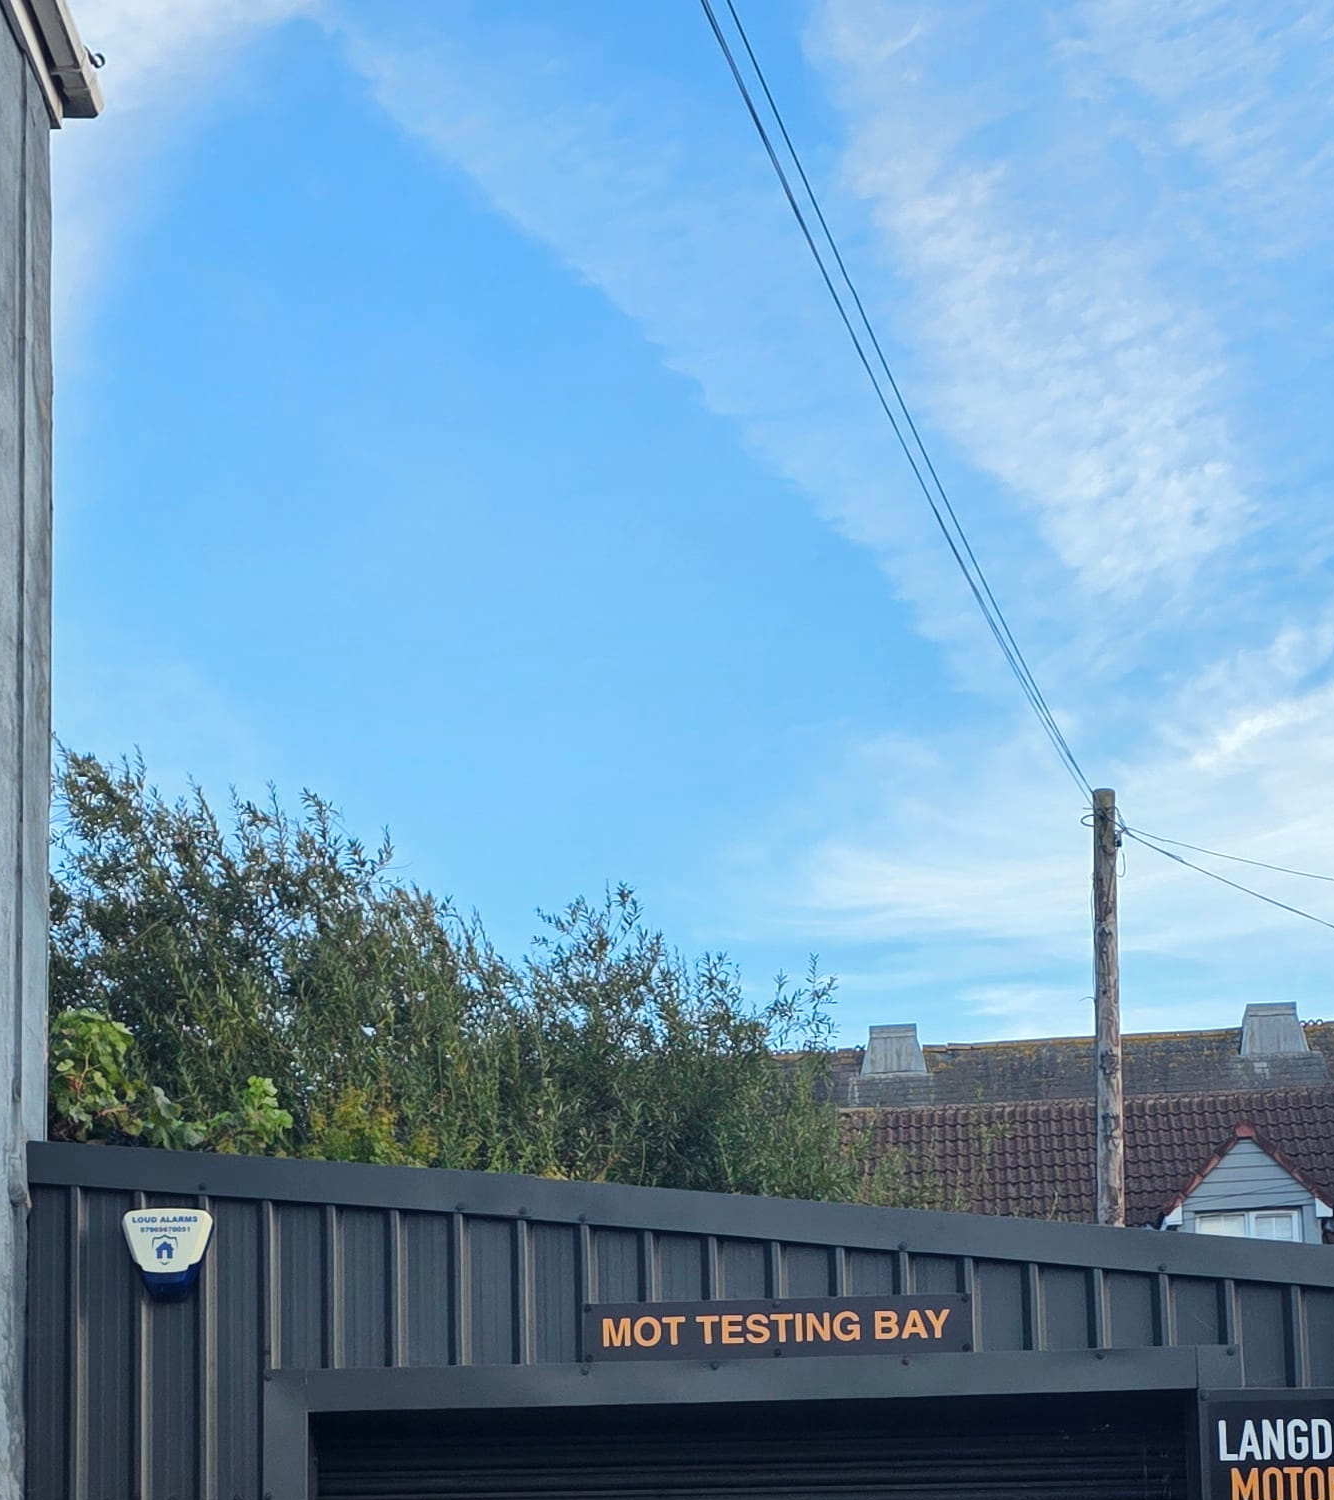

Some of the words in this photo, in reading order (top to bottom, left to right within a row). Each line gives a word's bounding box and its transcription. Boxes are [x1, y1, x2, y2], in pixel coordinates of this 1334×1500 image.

[160, 1215, 198, 1223] ALARMS
[602, 1315, 685, 1347] MOT
[696, 1311, 861, 1344] TESTING
[874, 1308, 950, 1340] BAY
